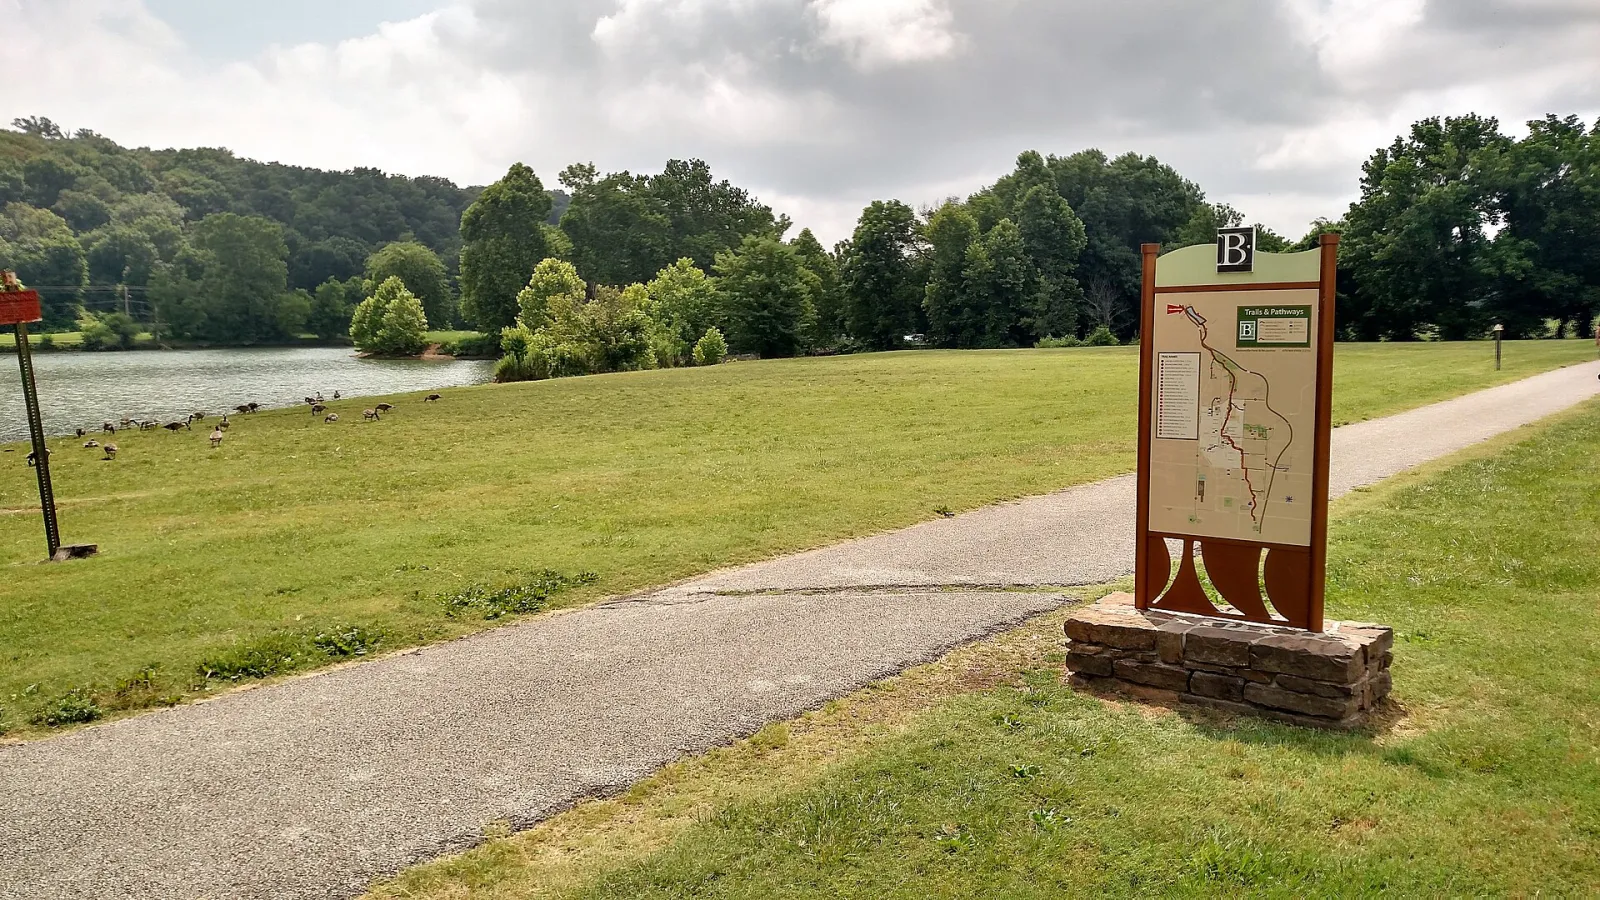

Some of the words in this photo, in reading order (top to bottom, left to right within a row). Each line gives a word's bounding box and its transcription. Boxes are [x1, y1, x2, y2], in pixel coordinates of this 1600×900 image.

[1244, 308, 1263, 316] Trails
[1263, 308, 1270, 316] &
[1270, 308, 1304, 317] Pathways
